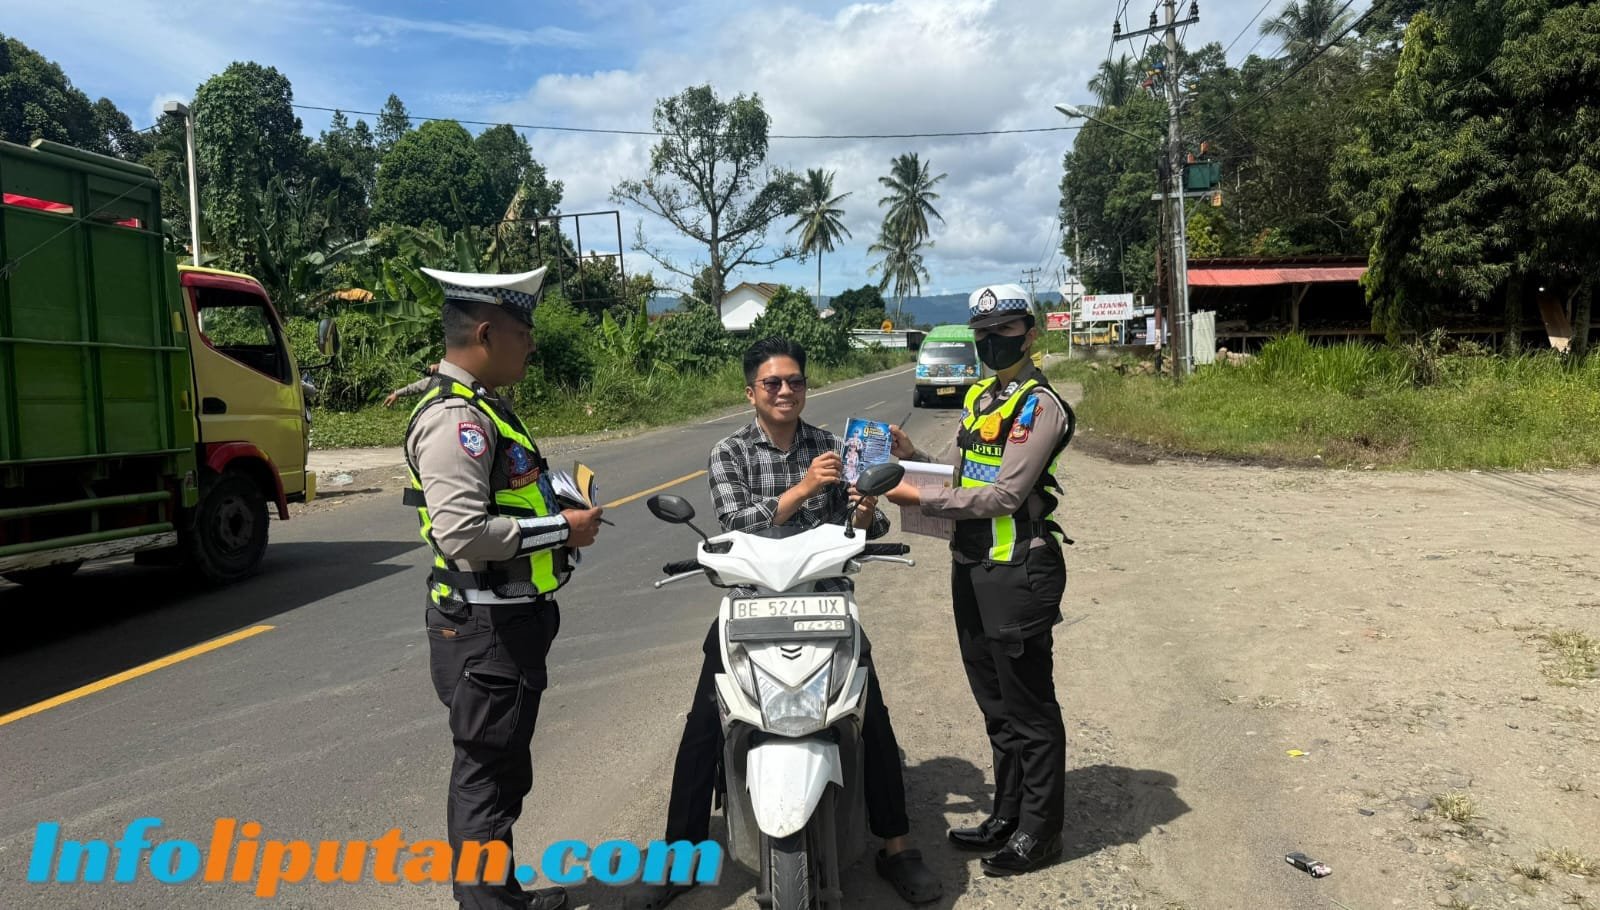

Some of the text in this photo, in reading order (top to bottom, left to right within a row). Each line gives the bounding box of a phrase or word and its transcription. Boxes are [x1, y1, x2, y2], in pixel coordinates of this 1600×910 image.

[738, 599, 839, 617] BE 5241 UX
